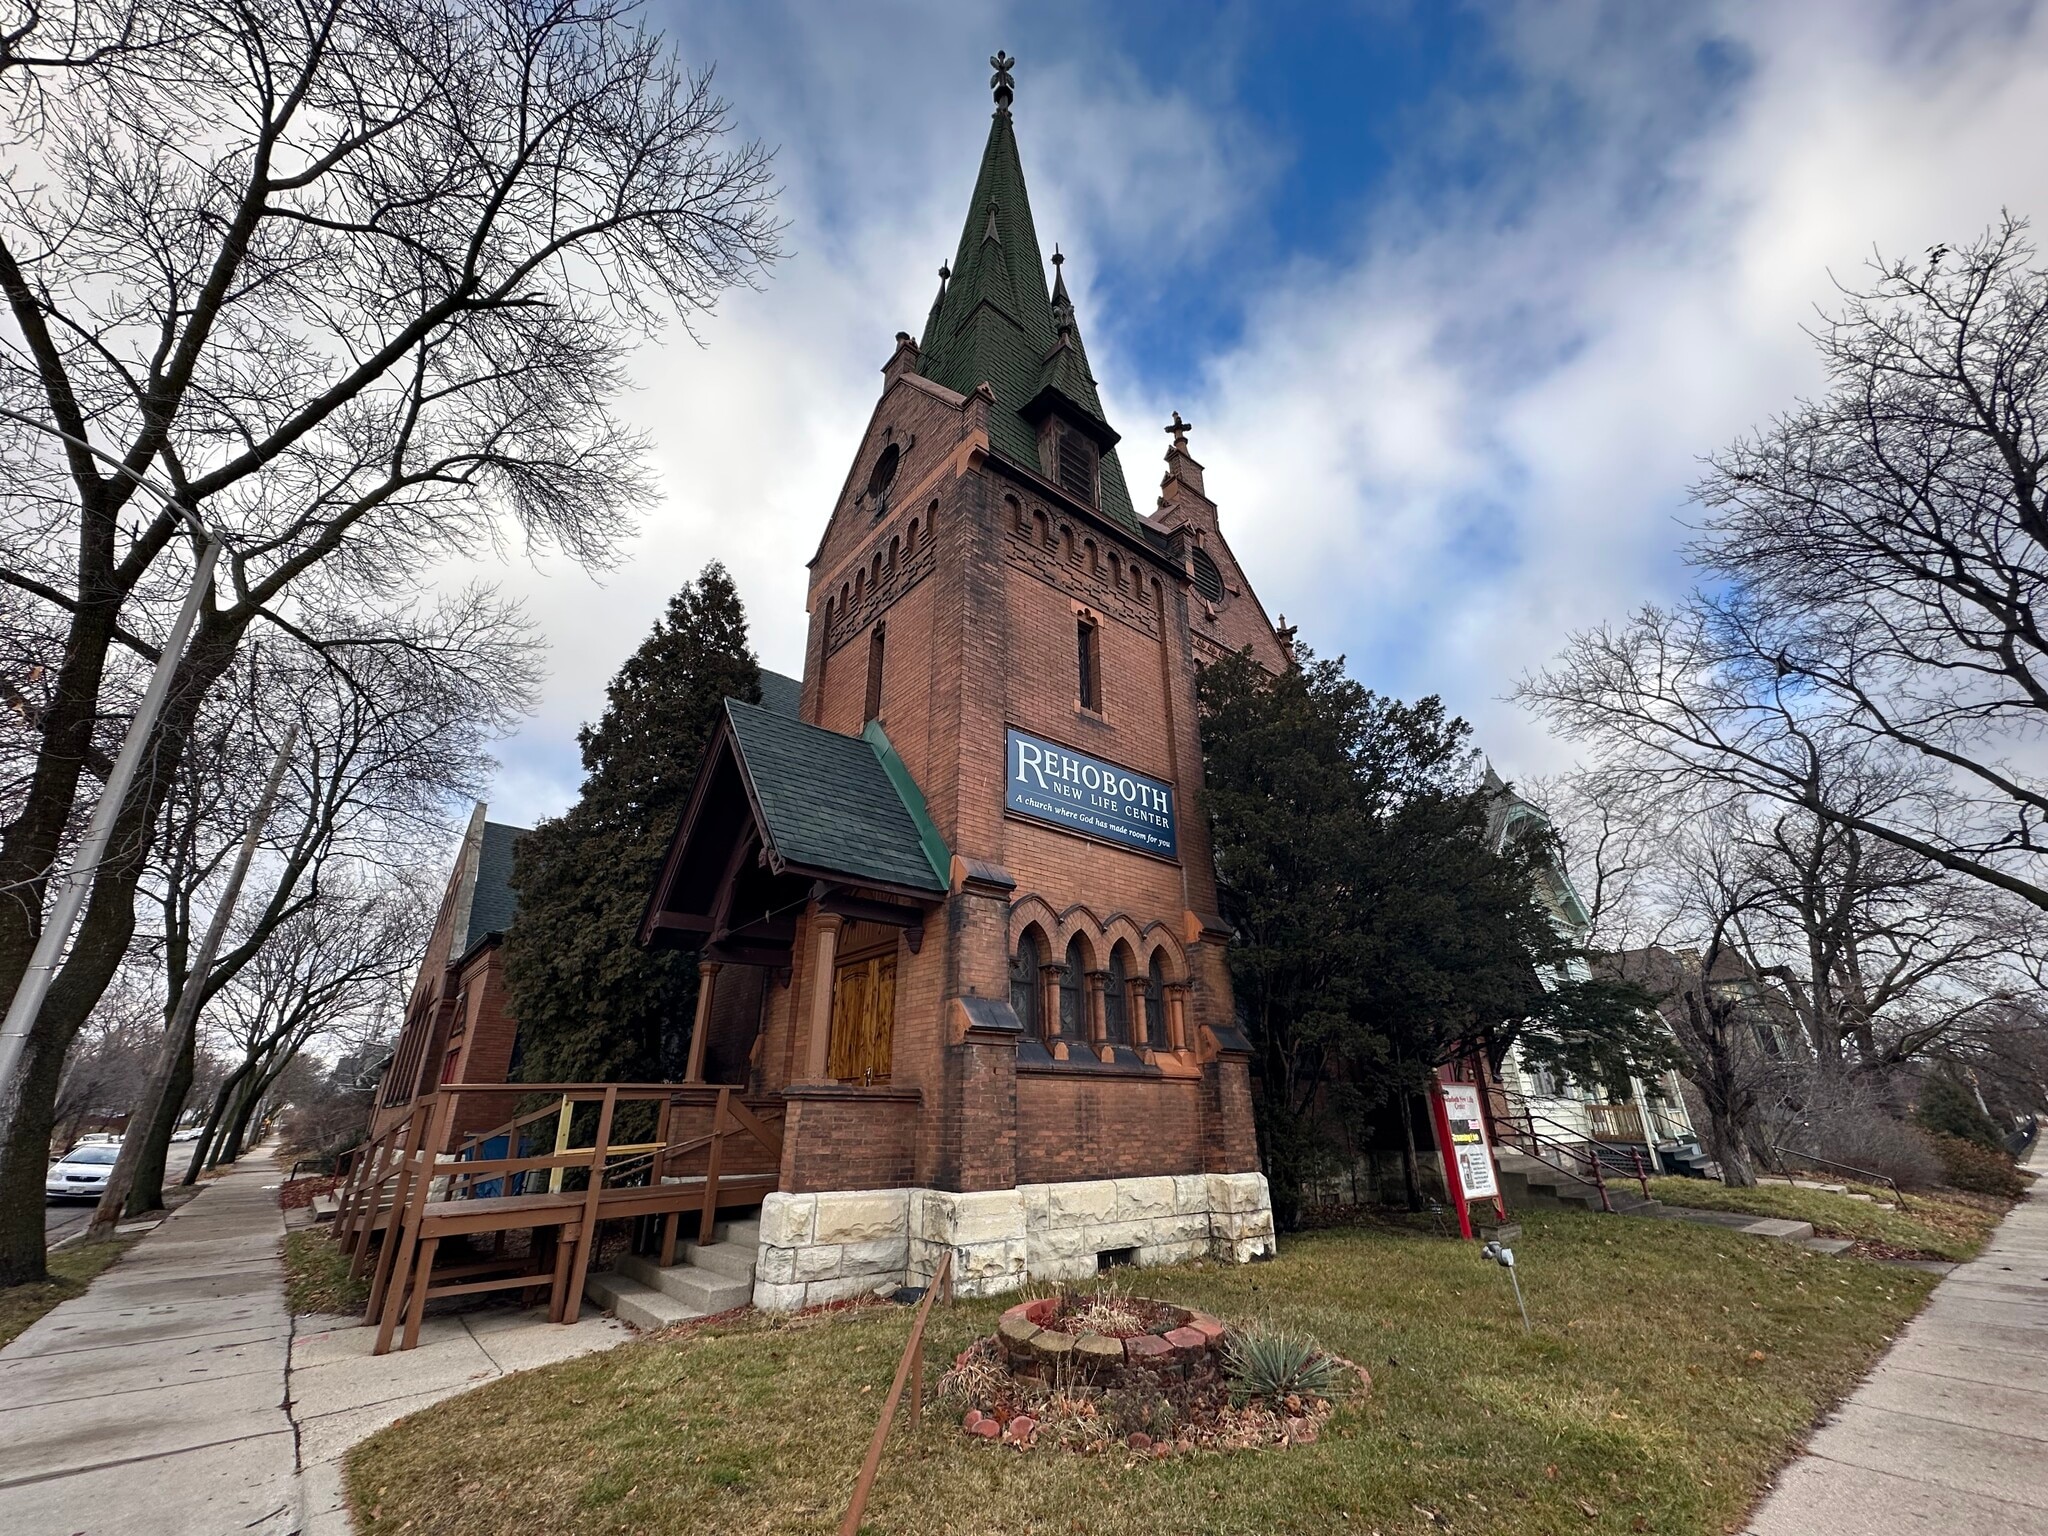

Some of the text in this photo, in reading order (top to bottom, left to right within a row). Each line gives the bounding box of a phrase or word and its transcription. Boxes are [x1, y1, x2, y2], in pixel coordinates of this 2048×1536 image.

[1015, 740, 1168, 814] REHOBOTH
[1016, 795, 1170, 848] A church where God has made room for you
[1053, 782, 1169, 828] NEW LIFE CENTER
